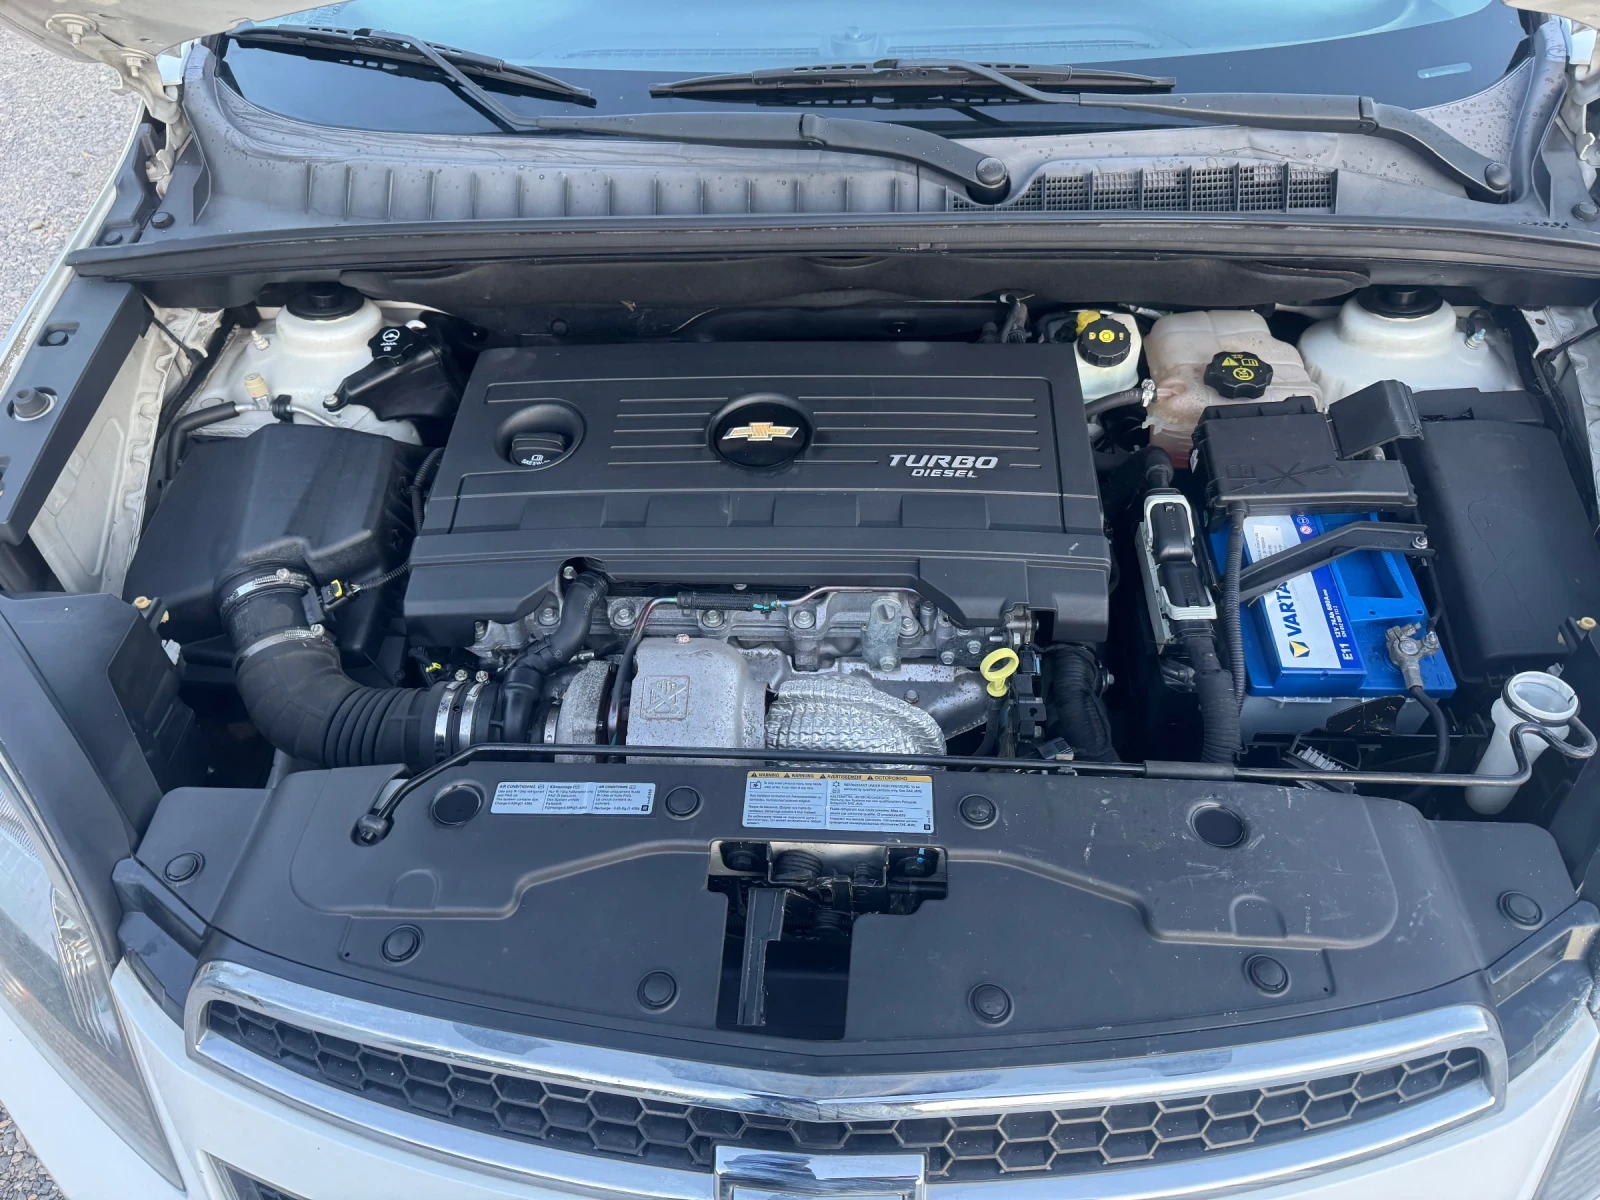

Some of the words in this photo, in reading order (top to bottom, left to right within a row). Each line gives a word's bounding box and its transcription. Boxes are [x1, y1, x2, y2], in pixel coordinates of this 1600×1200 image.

[889, 454, 998, 468] TURBO
[911, 469, 978, 478] DIESEL
[1276, 582, 1302, 637] VARTA
[1333, 627, 1341, 638] 12V
[1339, 643, 1354, 660] E11
